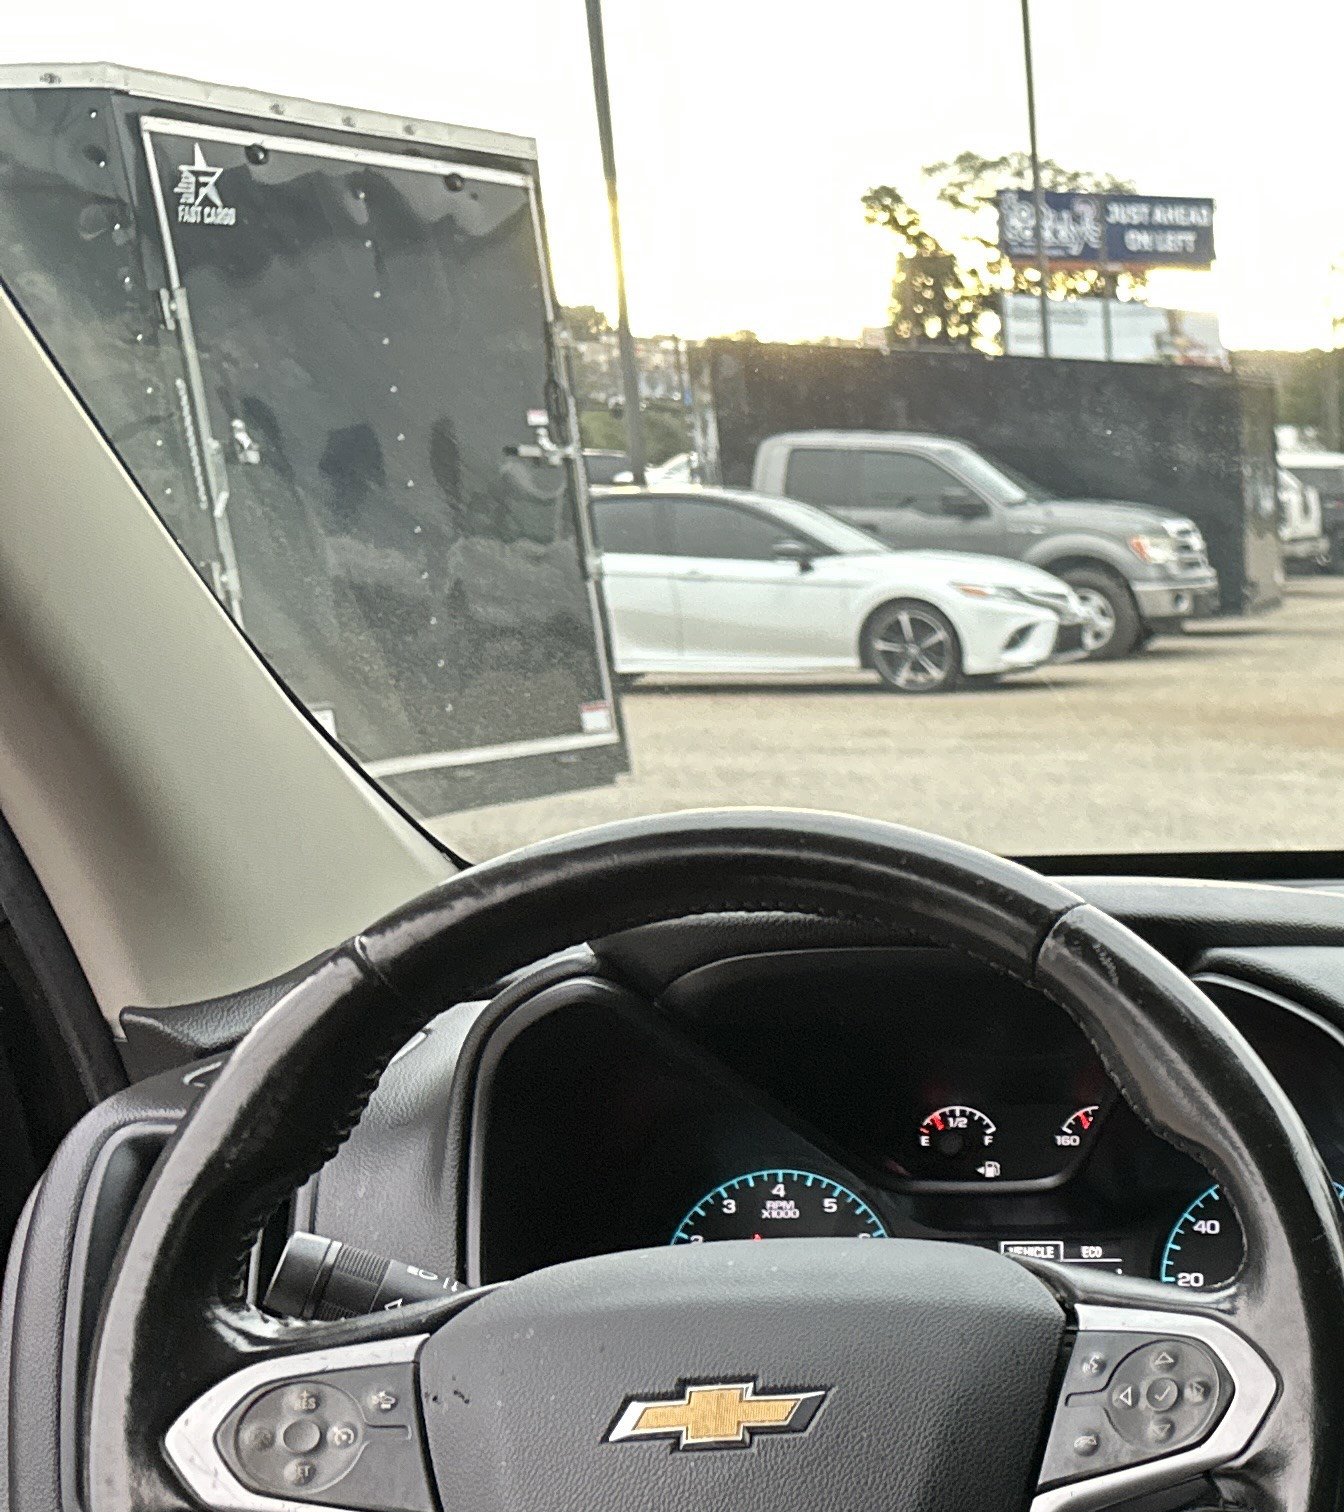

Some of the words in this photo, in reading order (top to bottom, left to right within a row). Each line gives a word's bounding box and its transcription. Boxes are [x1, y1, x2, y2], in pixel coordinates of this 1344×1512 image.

[178, 204, 202, 223] FAST
[919, 1135, 931, 1147] E
[983, 1135, 994, 1147] F
[1054, 1135, 1081, 1147] 160
[771, 1183, 786, 1198] 4
[722, 1199, 737, 1214] 3
[765, 1200, 795, 1211] RPM
[823, 1198, 838, 1213] 5
[1193, 1220, 1220, 1235] 40
[1081, 1246, 1103, 1259] ECO
[1177, 1272, 1204, 1288] 20
